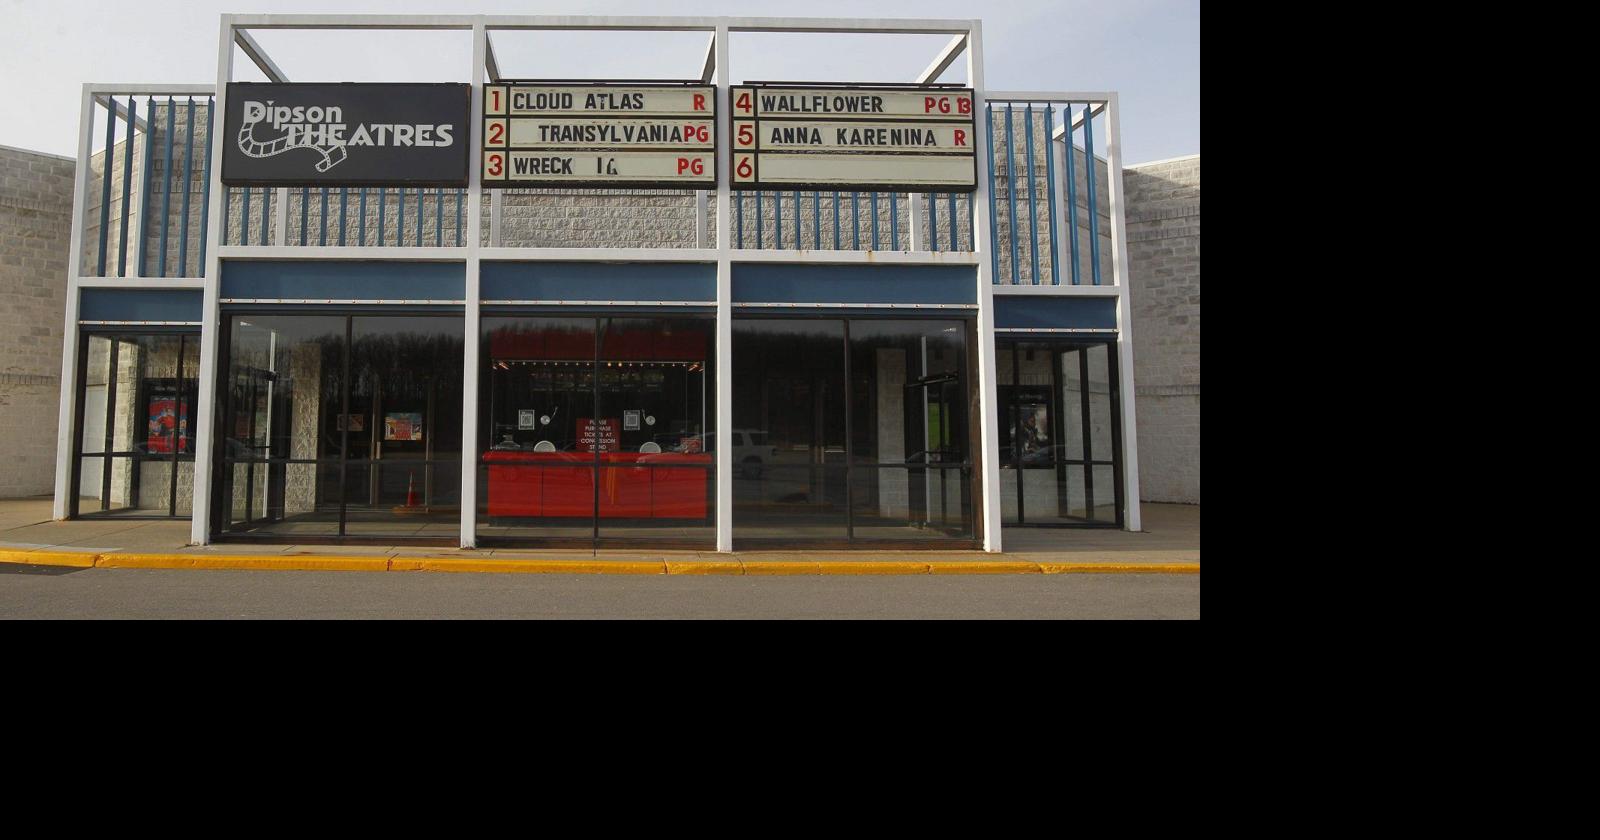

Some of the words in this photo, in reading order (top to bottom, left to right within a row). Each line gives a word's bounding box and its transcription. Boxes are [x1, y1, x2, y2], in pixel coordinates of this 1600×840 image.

[492, 91, 500, 111] 1
[513, 93, 573, 110] CLOUD
[585, 93, 643, 110] ATLAS
[693, 94, 706, 111] R
[735, 92, 752, 113] 4
[761, 95, 883, 113] WALLFLOWER
[924, 96, 950, 113] PG
[956, 96, 971, 114] 13
[243, 100, 342, 129] Dipson
[281, 122, 454, 147] THEATRES
[489, 123, 504, 145] 2
[538, 125, 682, 142] TRANSYLVANIA
[684, 125, 709, 143] PG
[737, 125, 753, 146] 5
[770, 127, 823, 145] ANNA
[837, 128, 937, 146] KARENINA
[953, 129, 966, 146] R
[488, 154, 503, 176] 3
[513, 156, 573, 175] WRECK
[677, 157, 704, 175] PG
[736, 157, 753, 178] 6
